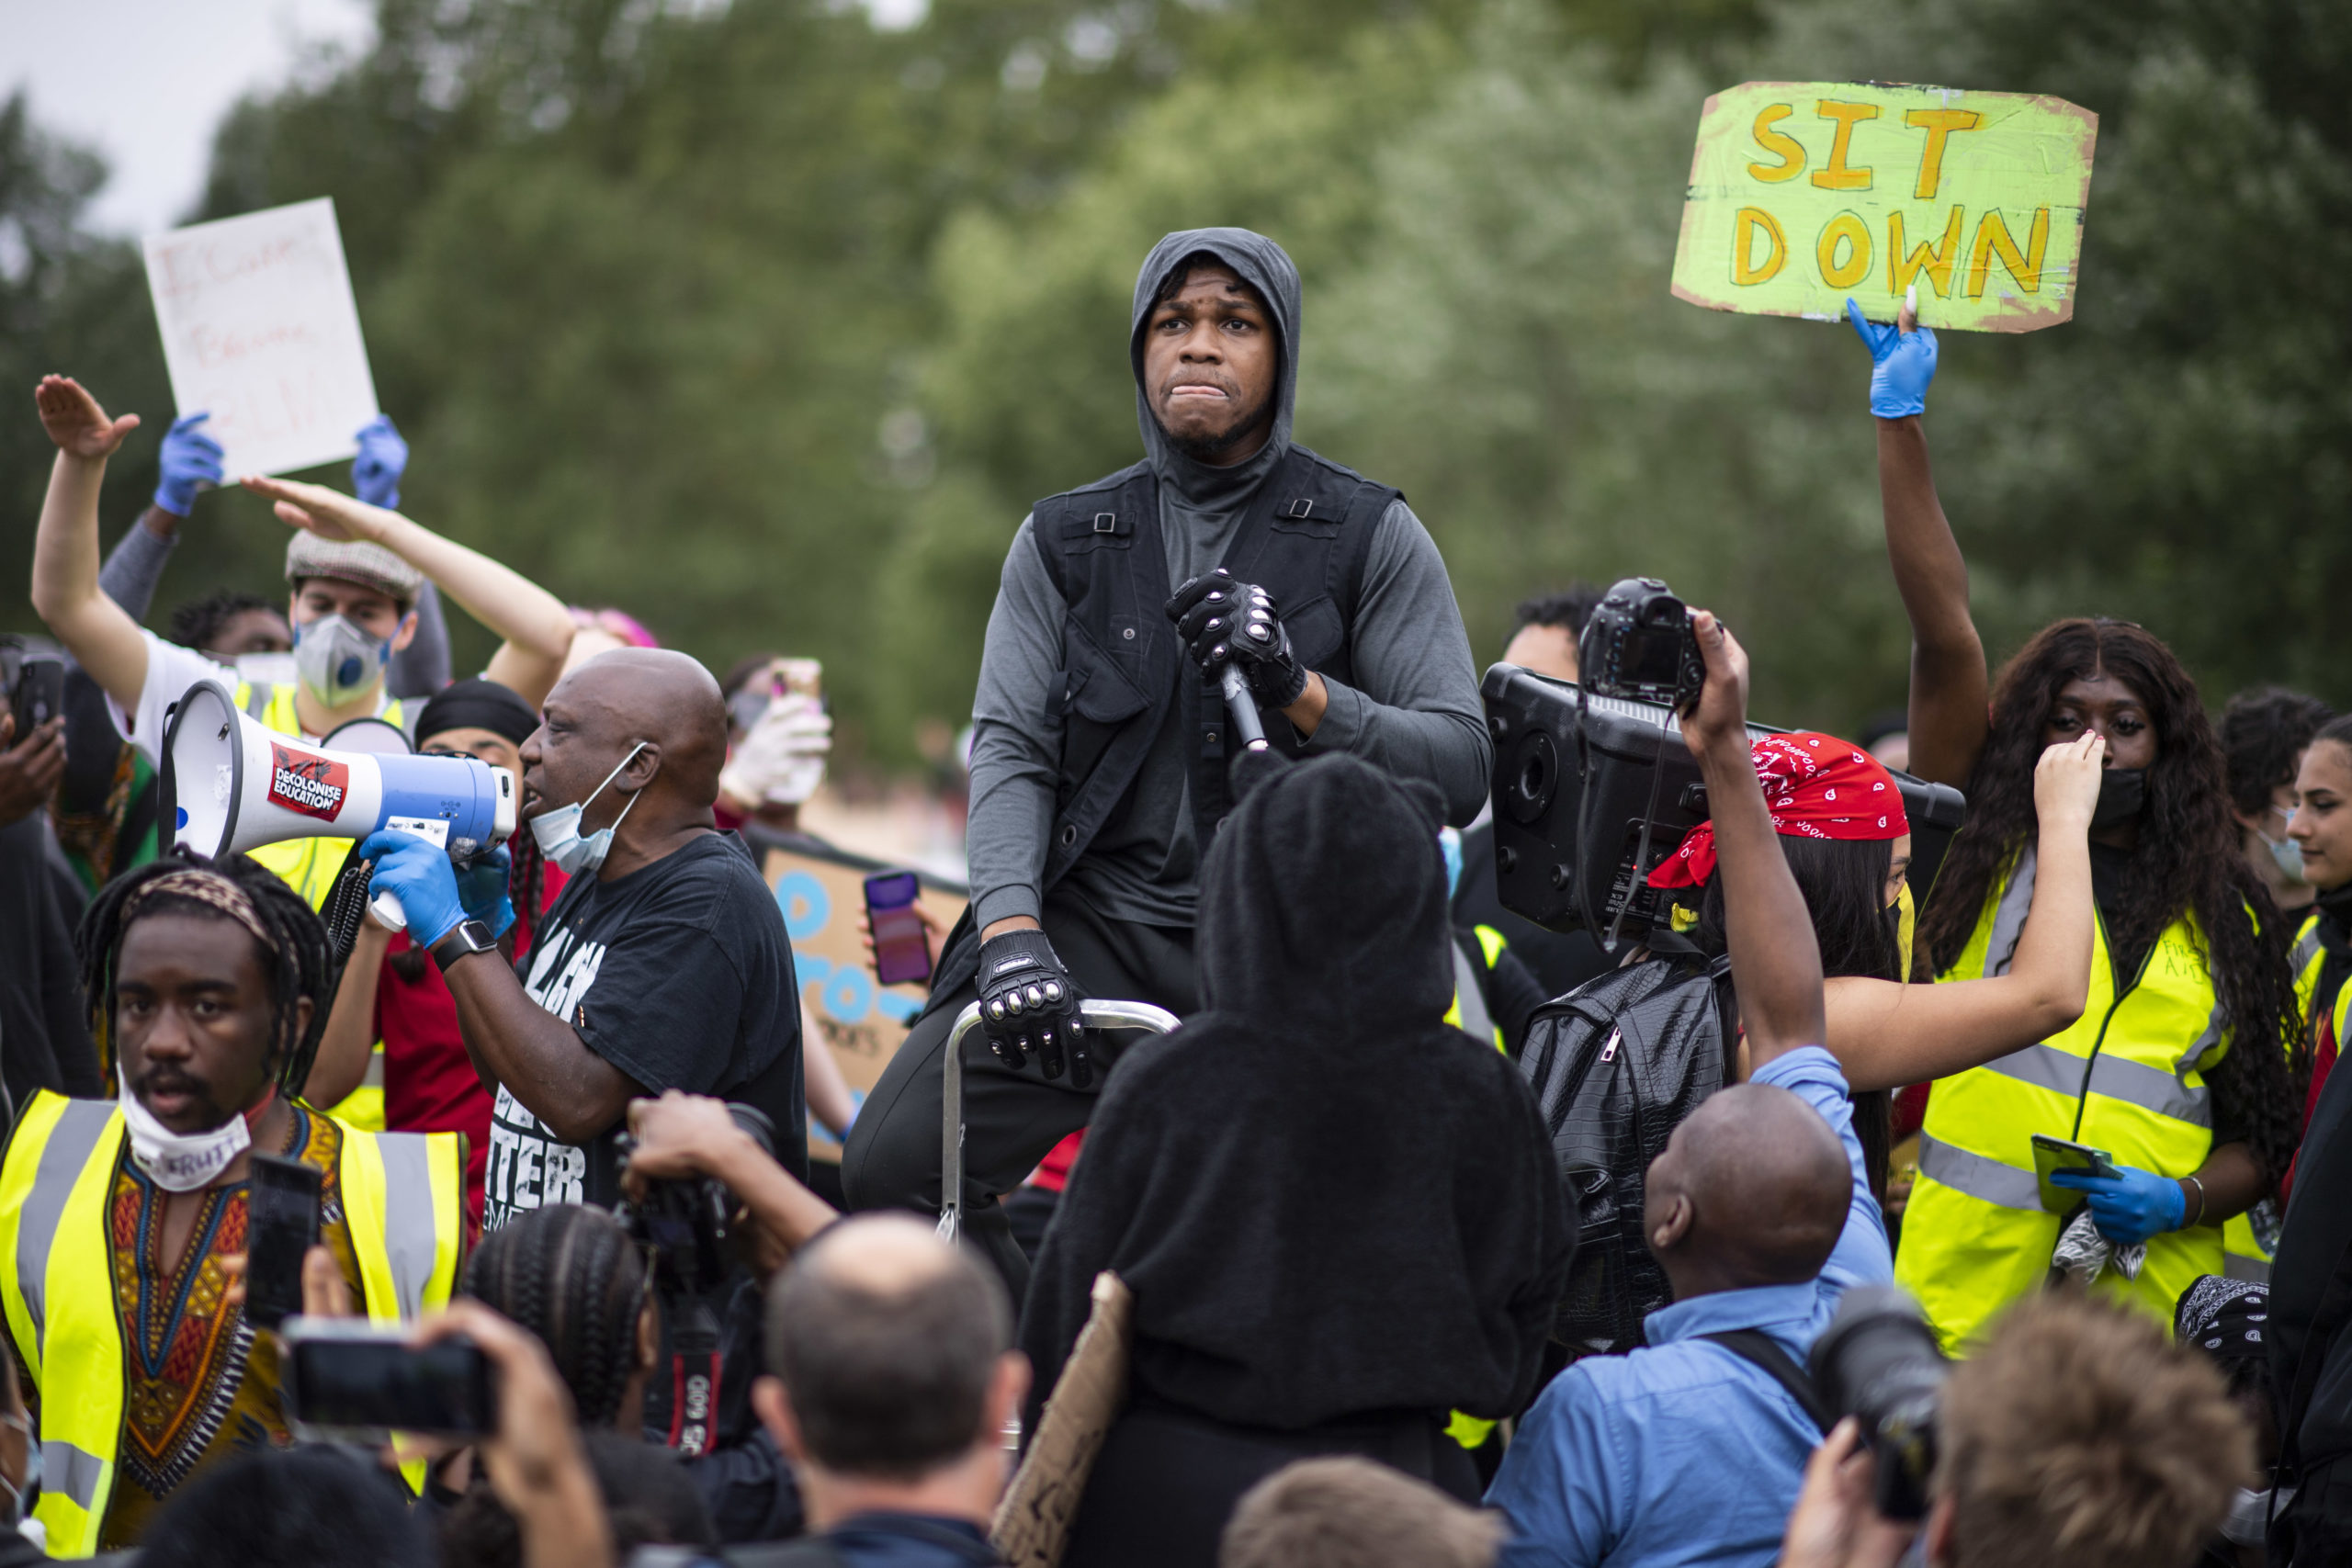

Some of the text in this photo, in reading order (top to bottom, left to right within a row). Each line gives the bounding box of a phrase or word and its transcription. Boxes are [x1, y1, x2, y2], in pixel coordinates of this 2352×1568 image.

[1747, 98, 1982, 199] SIT
[1730, 204, 2050, 299] DOWN
[274, 780, 334, 810] EDUCATION
[276, 767, 343, 801] DECOLONISE
[2164, 940, 2202, 962] FIRS
[686, 1375, 710, 1419] 60D
